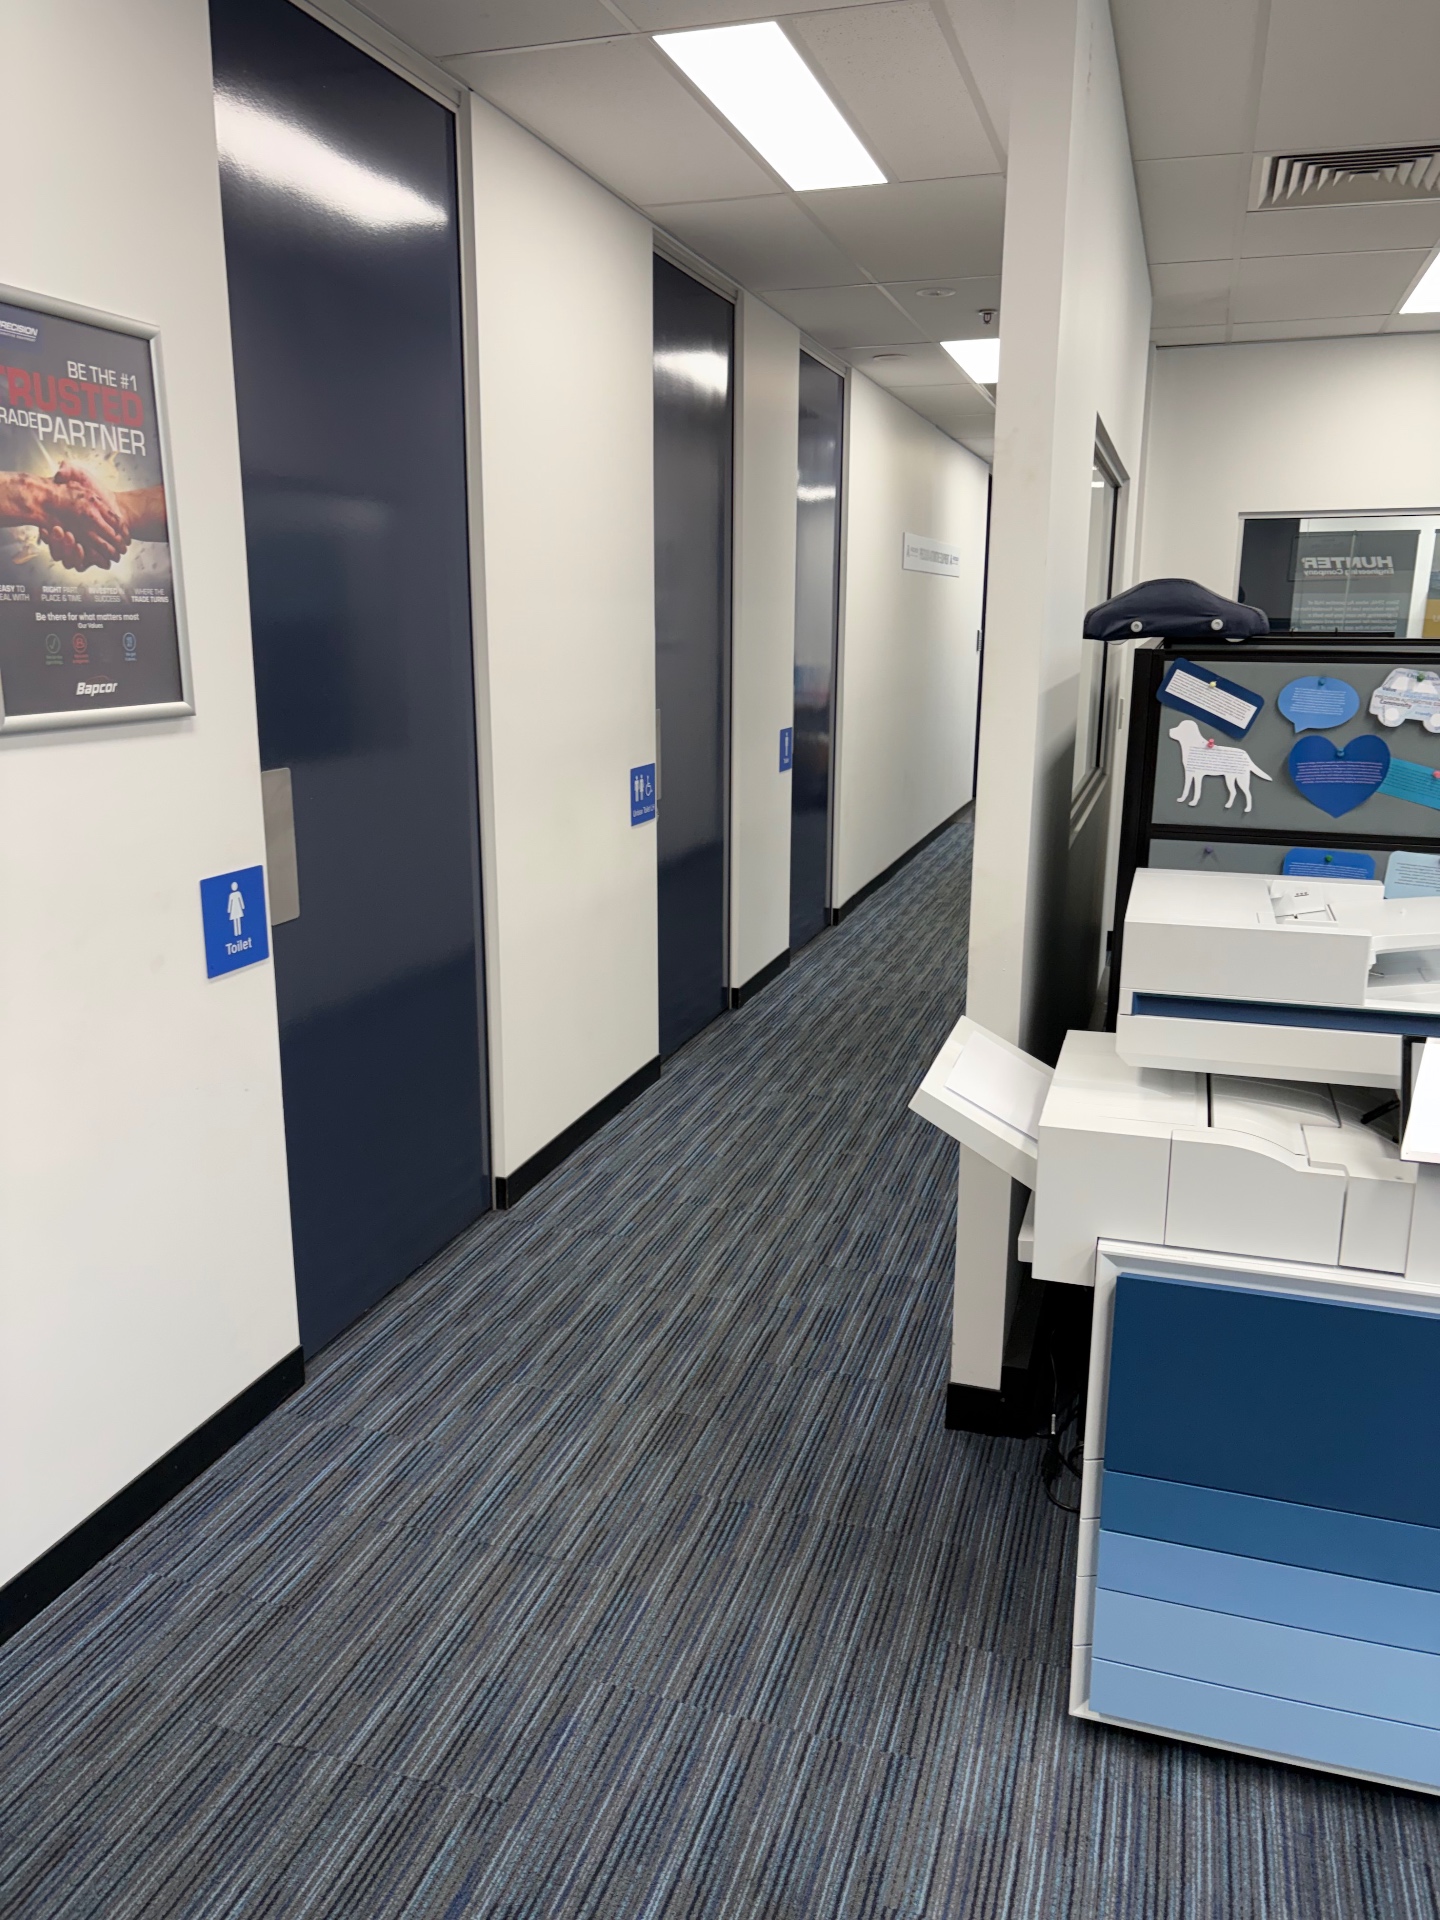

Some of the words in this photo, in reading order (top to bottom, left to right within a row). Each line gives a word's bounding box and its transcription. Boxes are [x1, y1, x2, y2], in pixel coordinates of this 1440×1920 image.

[0, 320, 38, 336] RECISION
[67, 360, 87, 381] BE
[89, 365, 117, 387] THE
[120, 373, 137, 391] #1
[0, 364, 144, 428] RUSTED
[42, 585, 62, 593] RIGHT
[0, 593, 12, 601] EAL
[12, 593, 30, 601] WITH
[35, 612, 46, 621] Be
[47, 611, 67, 621] there
[67, 611, 78, 621] for
[78, 611, 96, 621] what
[96, 612, 122, 621] matters
[123, 612, 140, 621] most
[76, 681, 118, 696] Bapcor
[225, 937, 252, 955] Toilet
